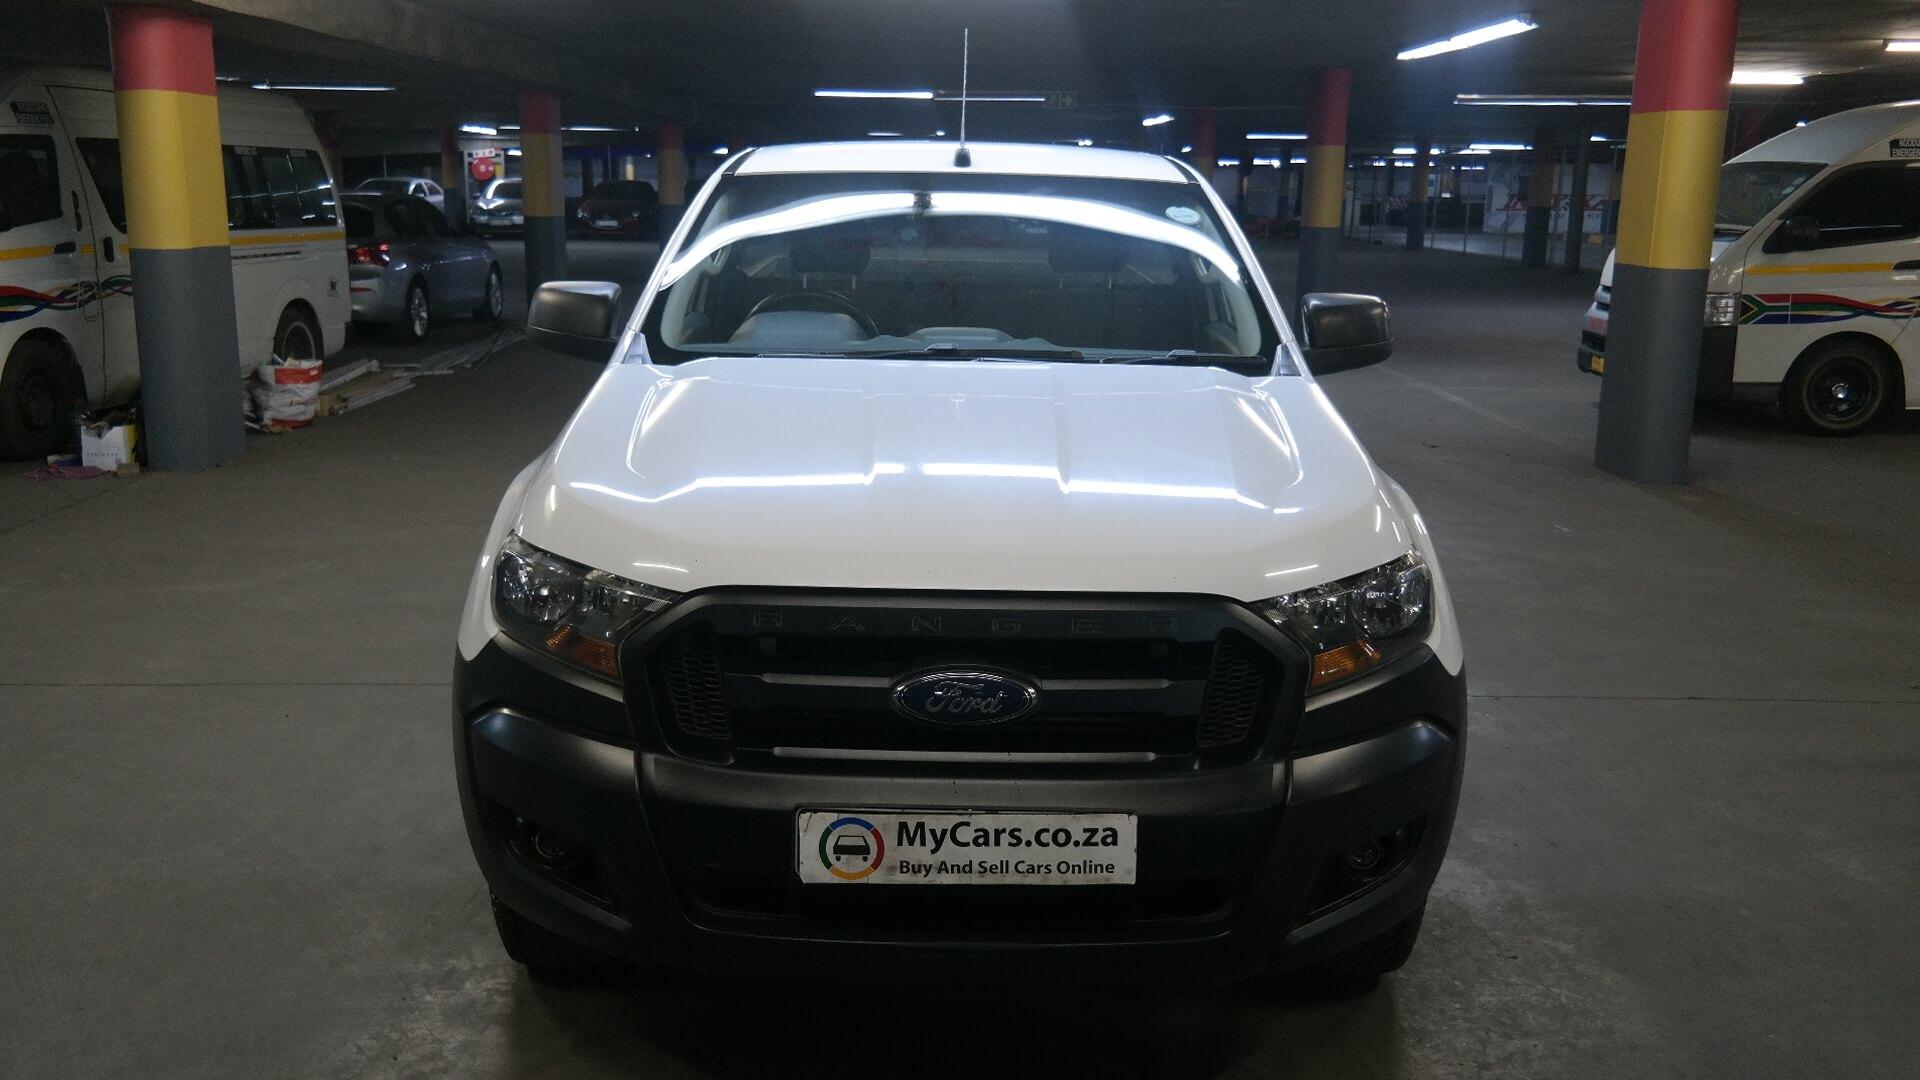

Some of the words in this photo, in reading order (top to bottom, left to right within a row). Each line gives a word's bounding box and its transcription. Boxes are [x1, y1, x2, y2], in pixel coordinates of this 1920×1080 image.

[752, 613, 1178, 634] RANGER
[926, 680, 1009, 713] Ford
[896, 821, 1119, 854] MyCars.co.za
[899, 860, 933, 877] Buy
[936, 860, 973, 875] And
[977, 860, 1010, 875] Sell
[1013, 861, 1052, 875] Cars
[1056, 860, 1116, 875] Online
